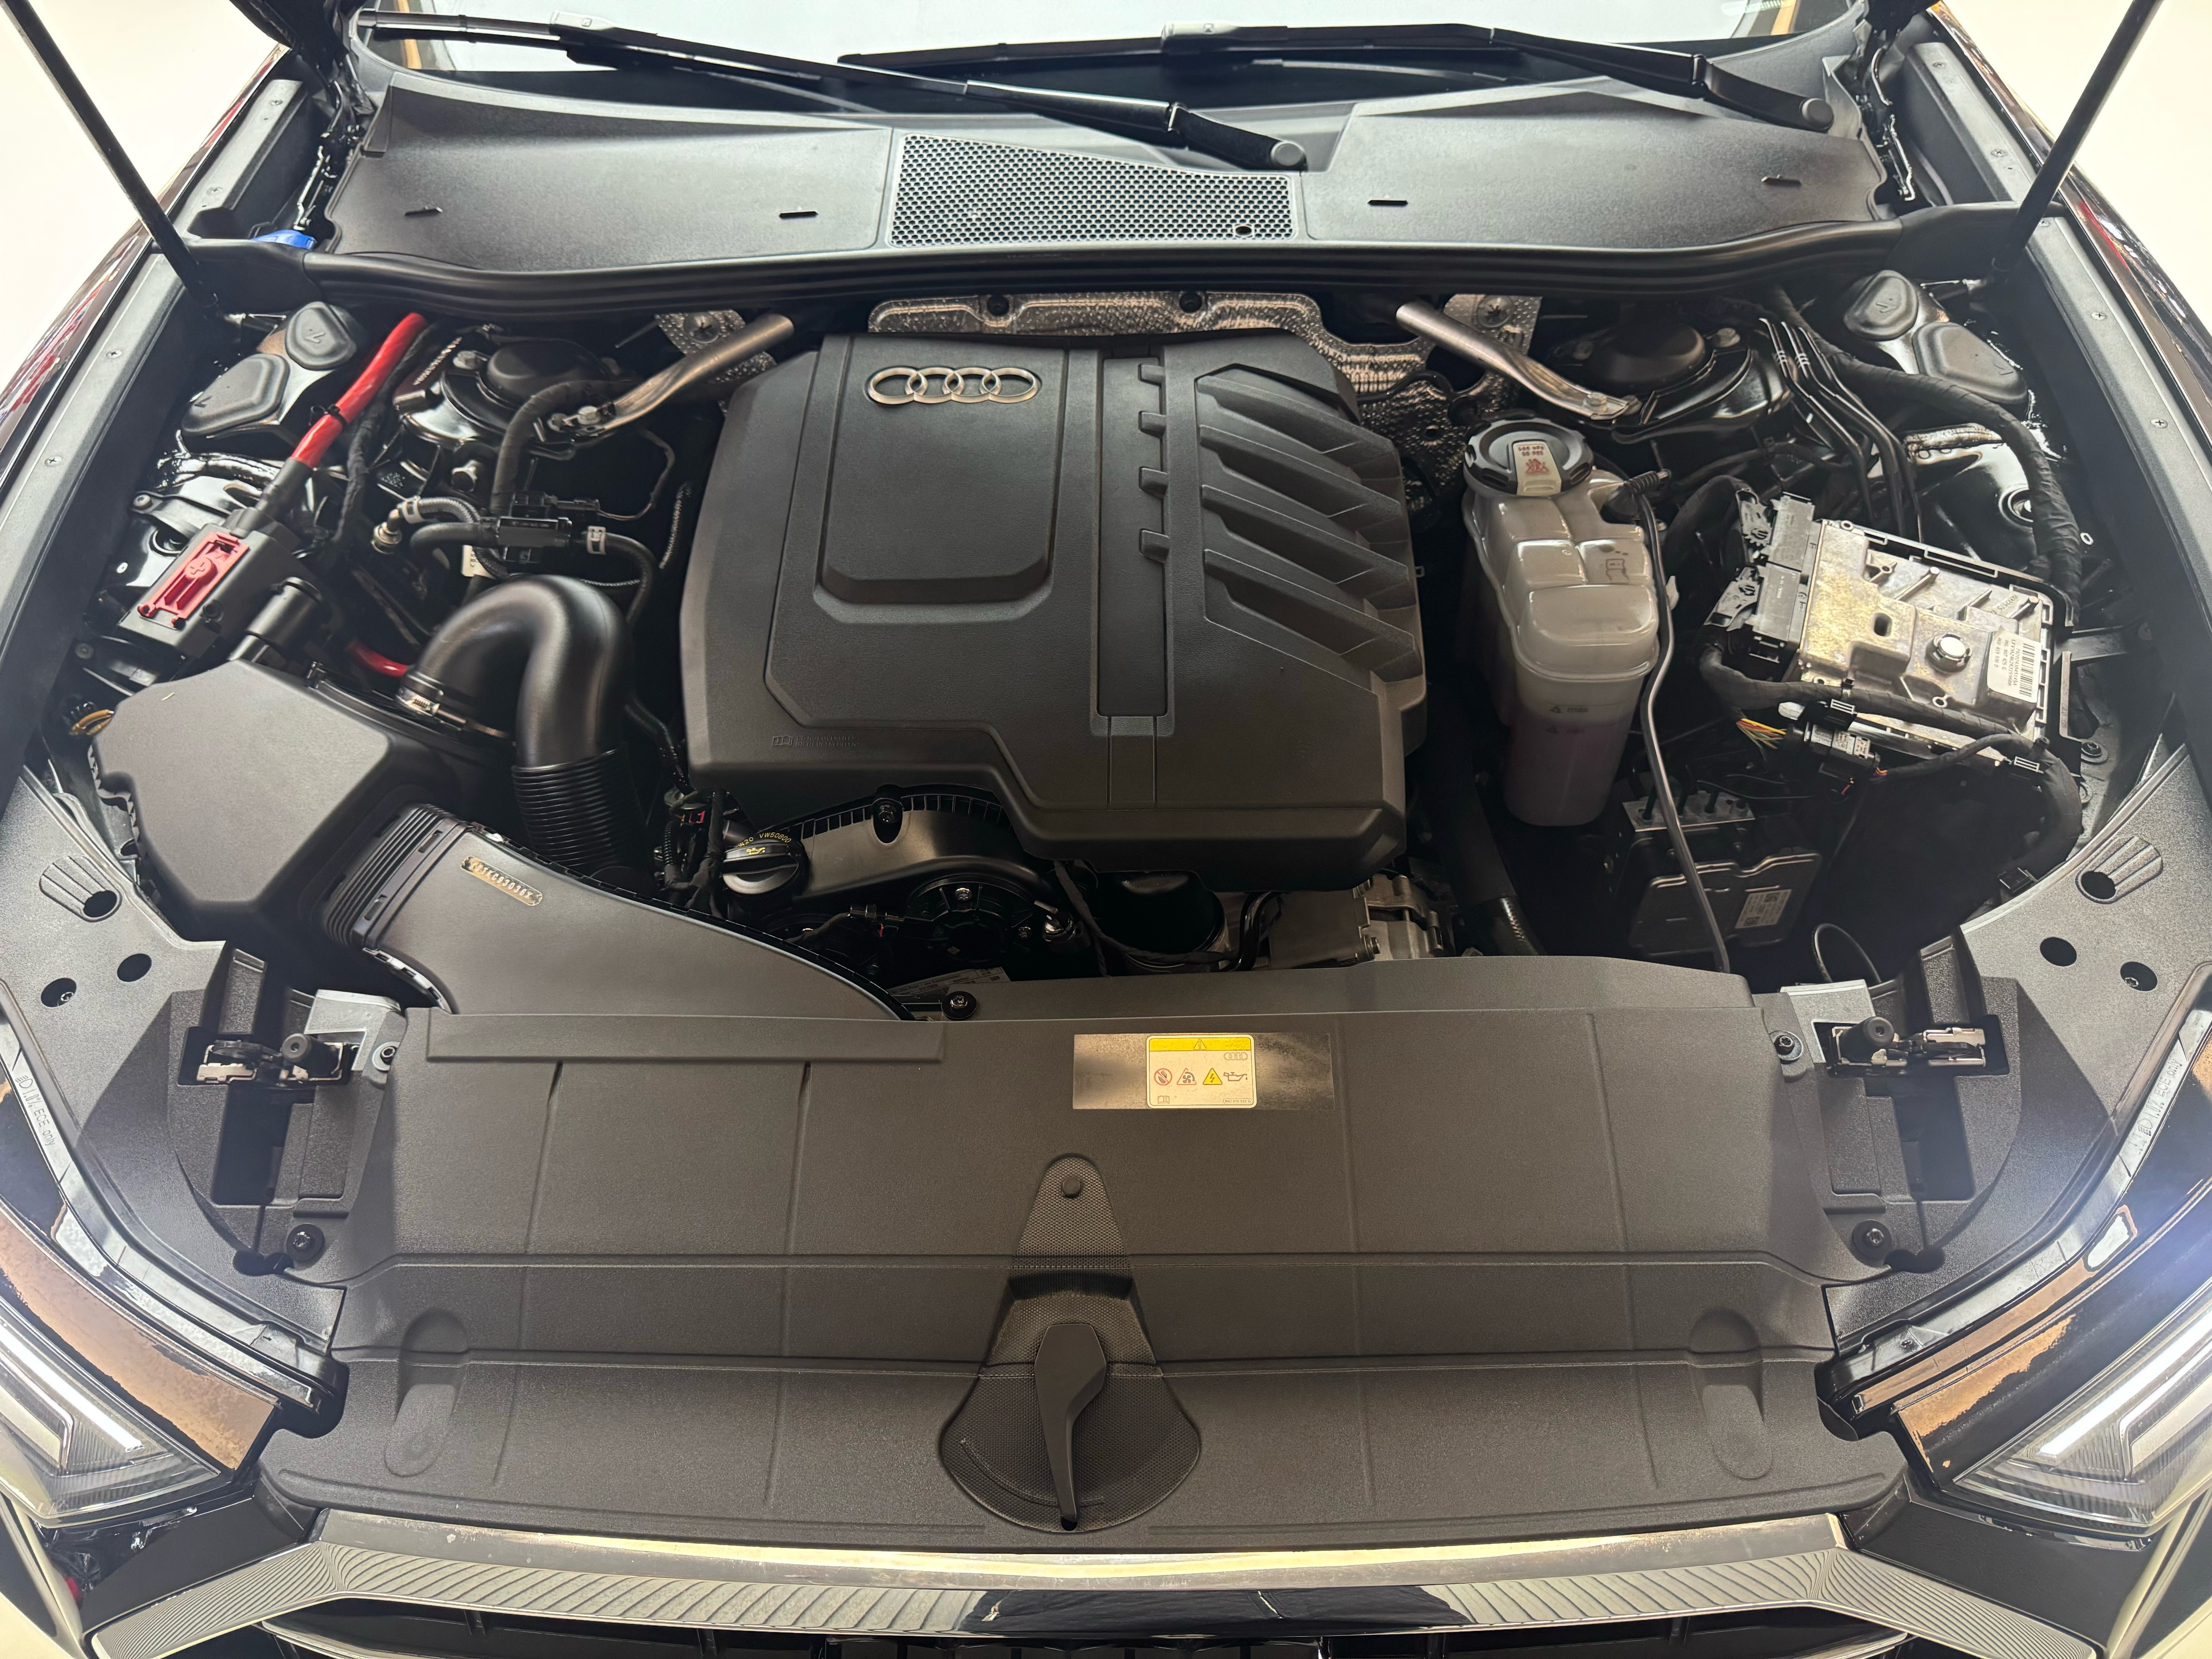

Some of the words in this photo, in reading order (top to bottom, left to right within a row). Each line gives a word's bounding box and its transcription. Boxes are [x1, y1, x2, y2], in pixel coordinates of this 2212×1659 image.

[759, 832, 792, 843] VW50800
[2154, 1077, 2171, 1097] ECE
[2167, 1058, 2183, 1076] only
[34, 1108, 50, 1128] ECE
[43, 1130, 56, 1146] only
